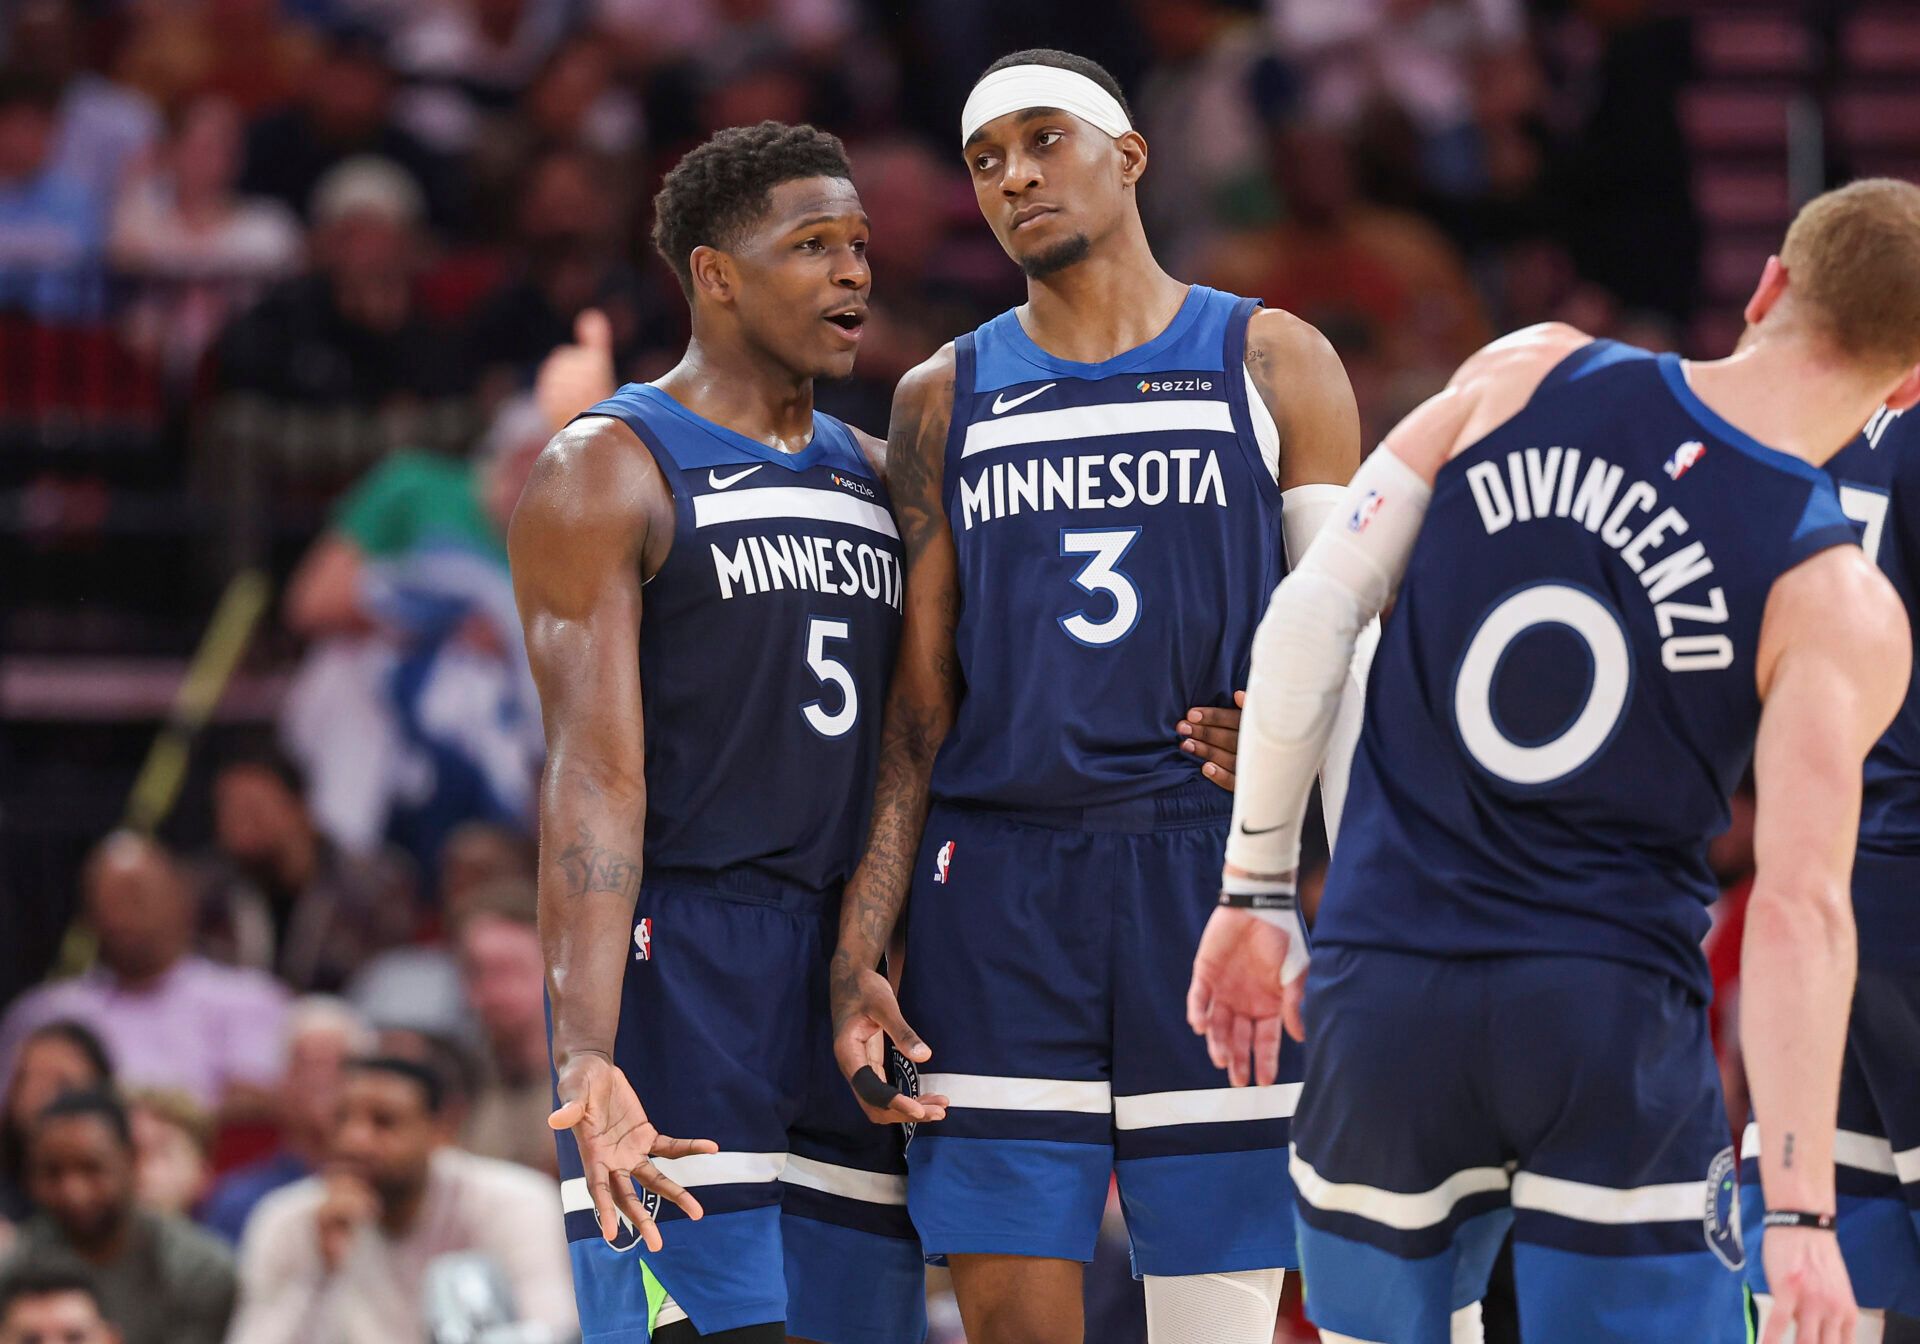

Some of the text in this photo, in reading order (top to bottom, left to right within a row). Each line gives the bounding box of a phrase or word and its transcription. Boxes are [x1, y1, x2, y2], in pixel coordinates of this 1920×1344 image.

[1151, 378, 1212, 392] sezzle
[840, 477, 875, 498] sezzle
[961, 449, 1227, 530] MINNESOTA
[711, 534, 903, 616] MINNESOTA
[1059, 527, 1141, 646] 3
[1466, 447, 1734, 672] DIVINCENZO
[803, 615, 858, 737] 5
